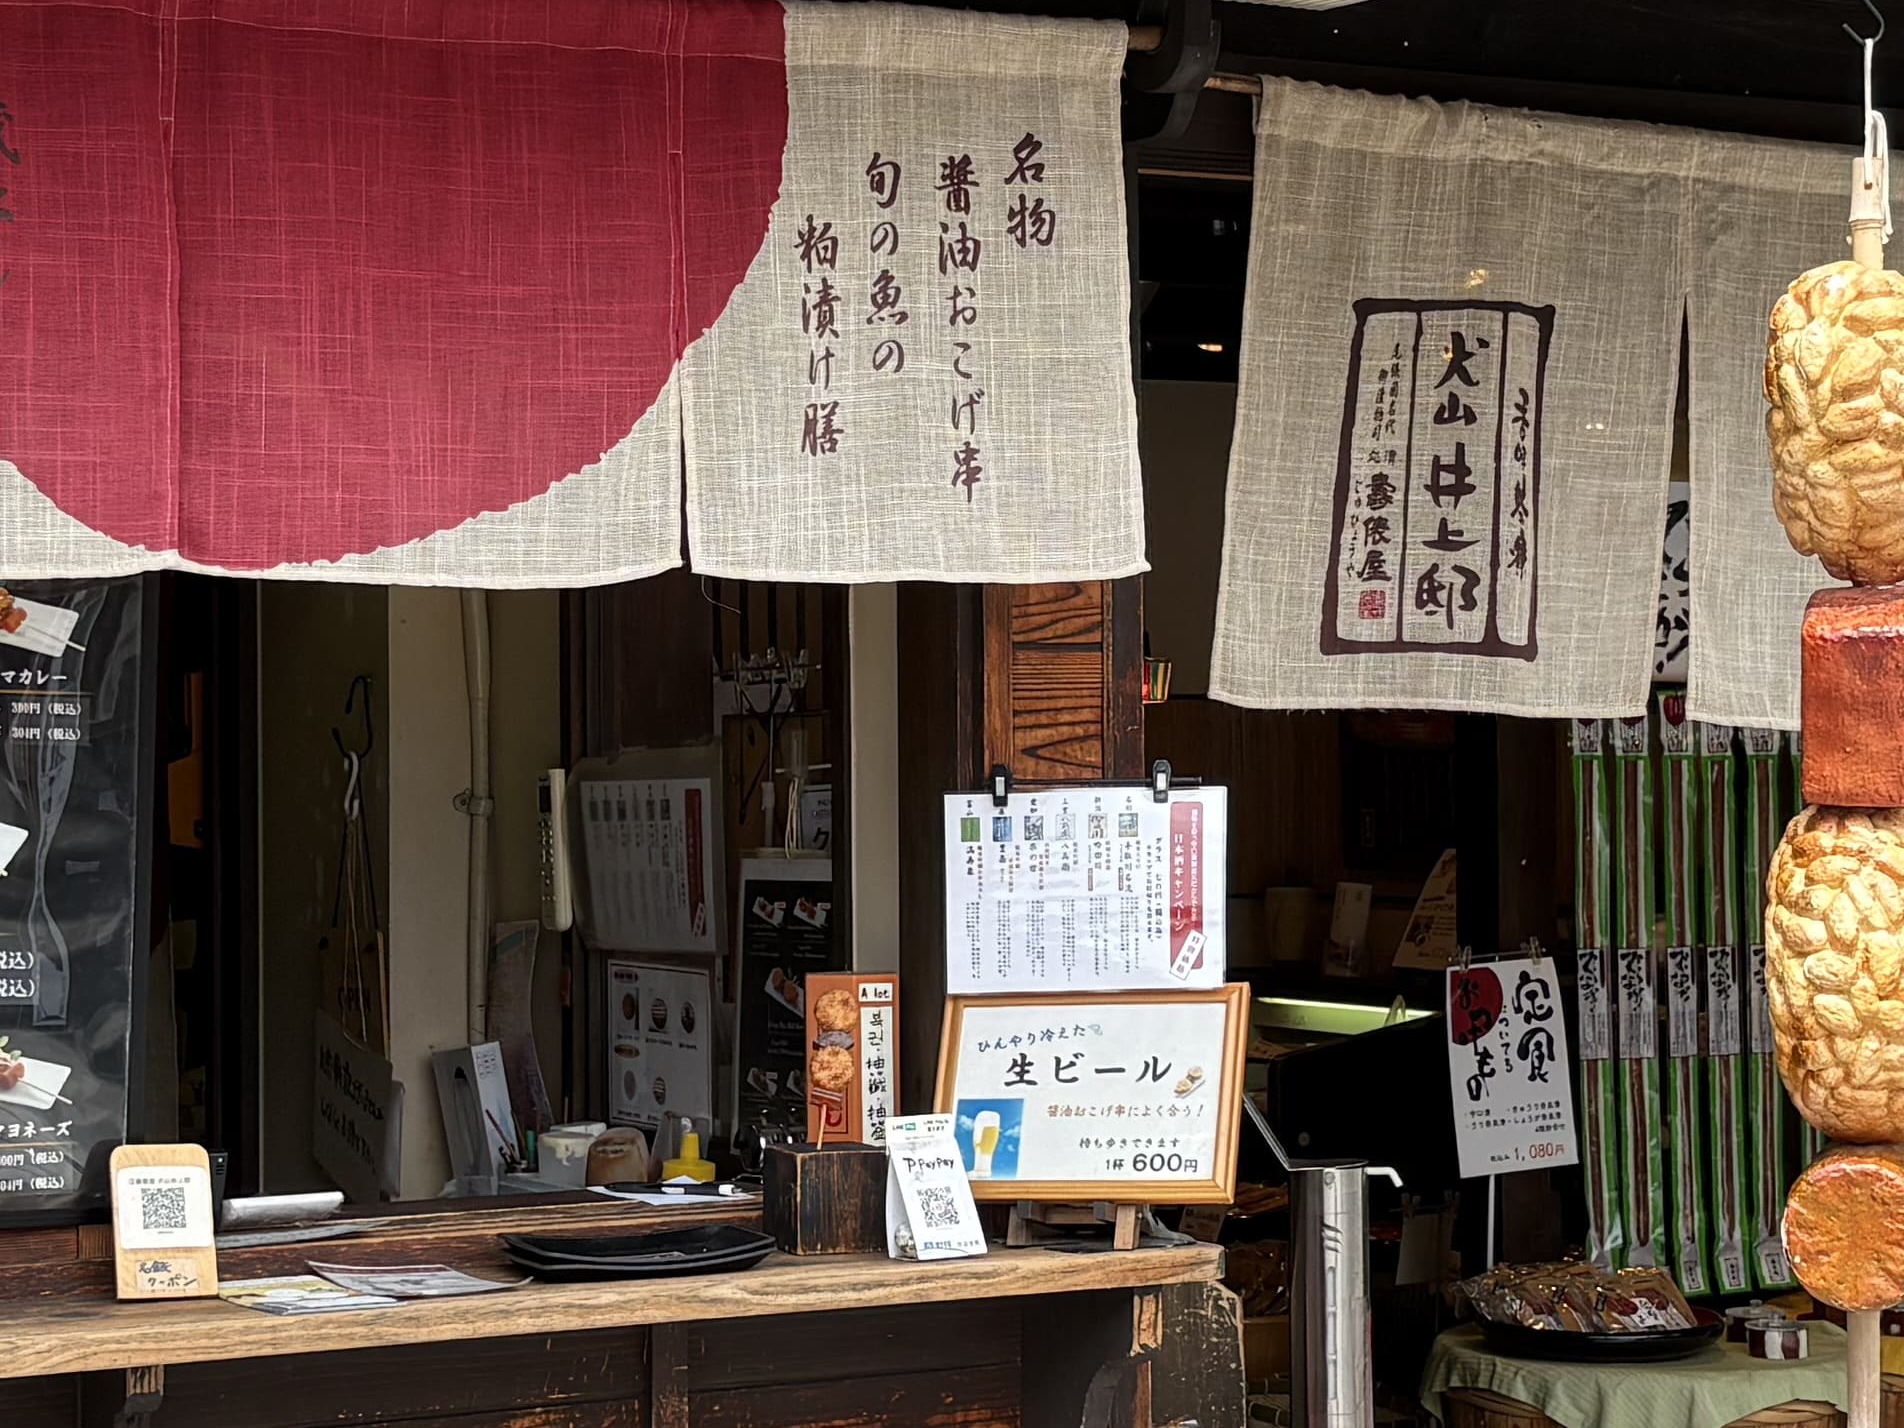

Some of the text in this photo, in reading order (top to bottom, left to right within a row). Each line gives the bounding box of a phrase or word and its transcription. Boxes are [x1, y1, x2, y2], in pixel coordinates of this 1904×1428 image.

[1003, 131, 1057, 249] 名物
[864, 151, 910, 374] 旬の魚の
[793, 213, 846, 459] 粕漬け膳
[934, 153, 986, 504] 醤油おこげ串
[1414, 330, 1491, 632] 犬山井上邸
[860, 987, 869, 1000] A
[976, 1023, 1088, 1055] ひんやり冷えた
[1511, 969, 1557, 1084] 定食
[1003, 1052, 1174, 1088] 生ビール
[1078, 1136, 1182, 1150] 持ち歩きできます
[1131, 1152, 1199, 1174] 600円
